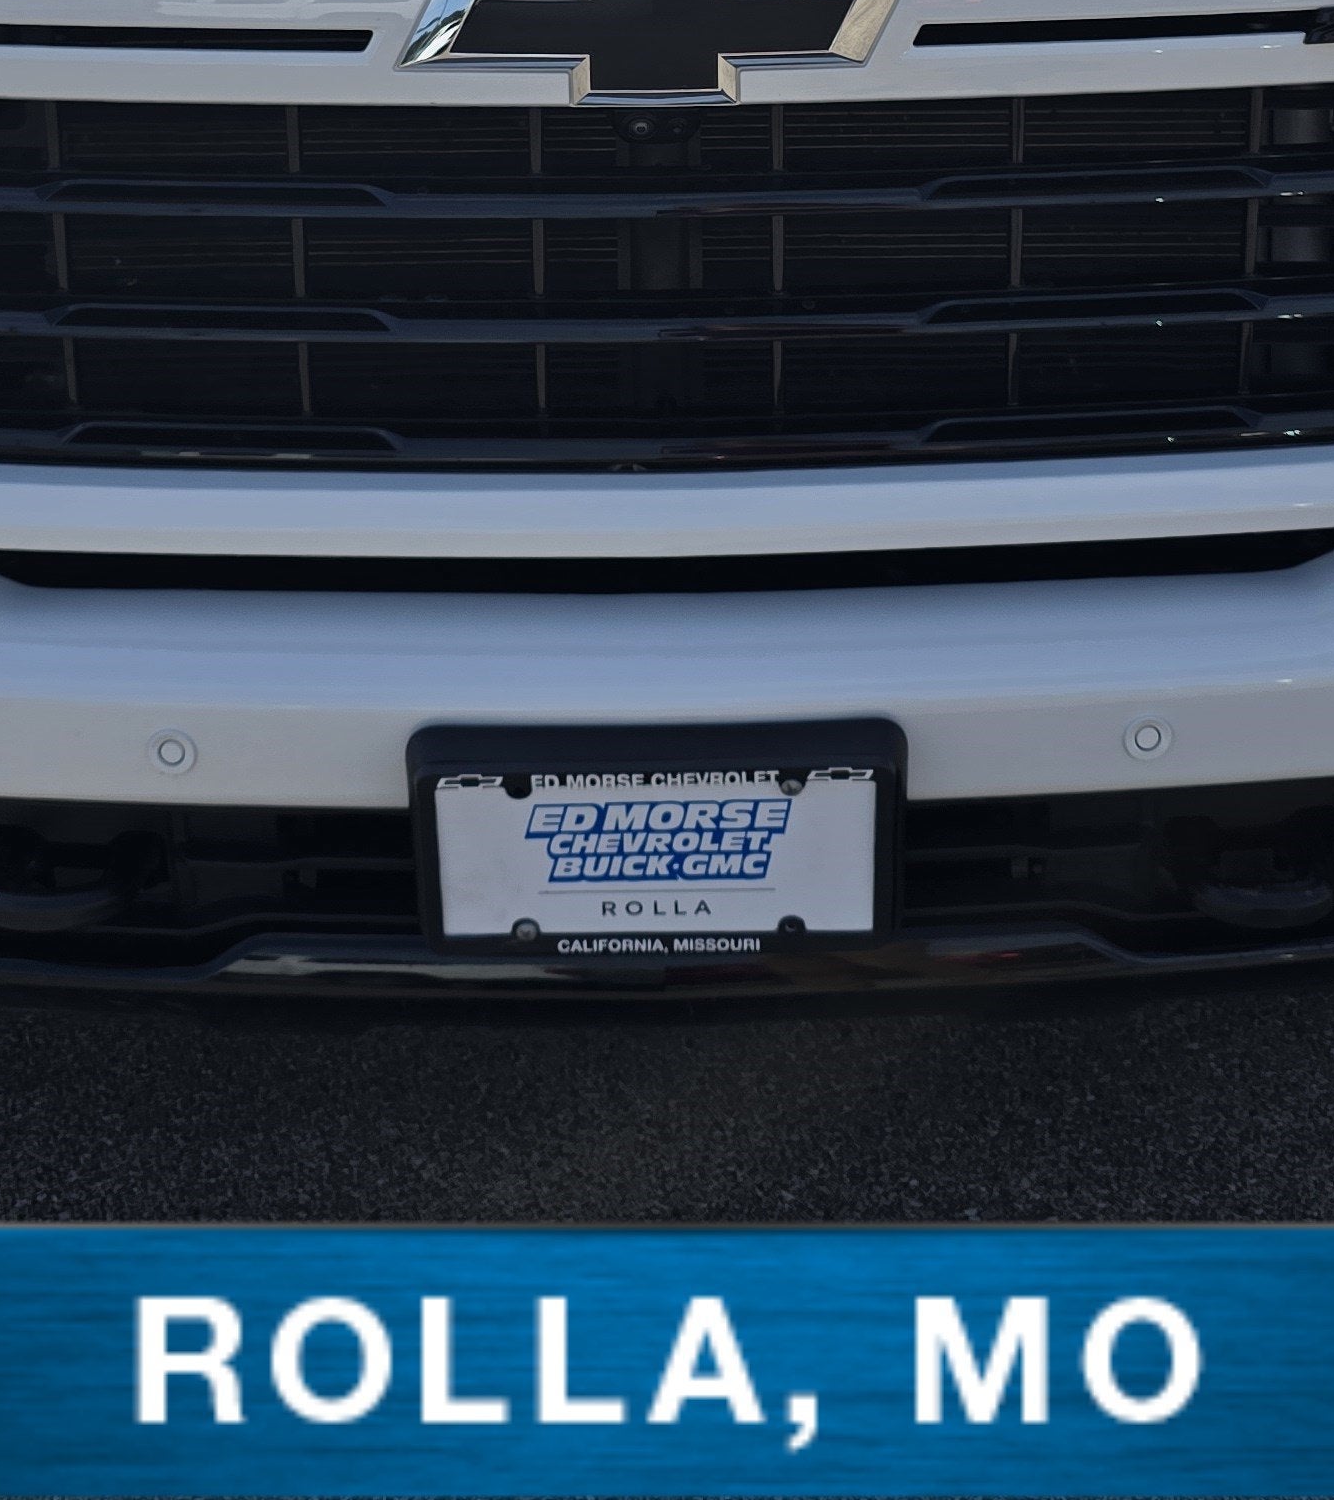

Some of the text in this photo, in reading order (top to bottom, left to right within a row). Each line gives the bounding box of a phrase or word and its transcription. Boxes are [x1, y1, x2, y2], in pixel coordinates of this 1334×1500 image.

[530, 770, 779, 789] ED MORSE CHEVROLET
[528, 800, 790, 833] ED MORSE
[601, 900, 712, 916] ROLLA
[557, 937, 761, 954] CALIFORNIA, MISSOURI
